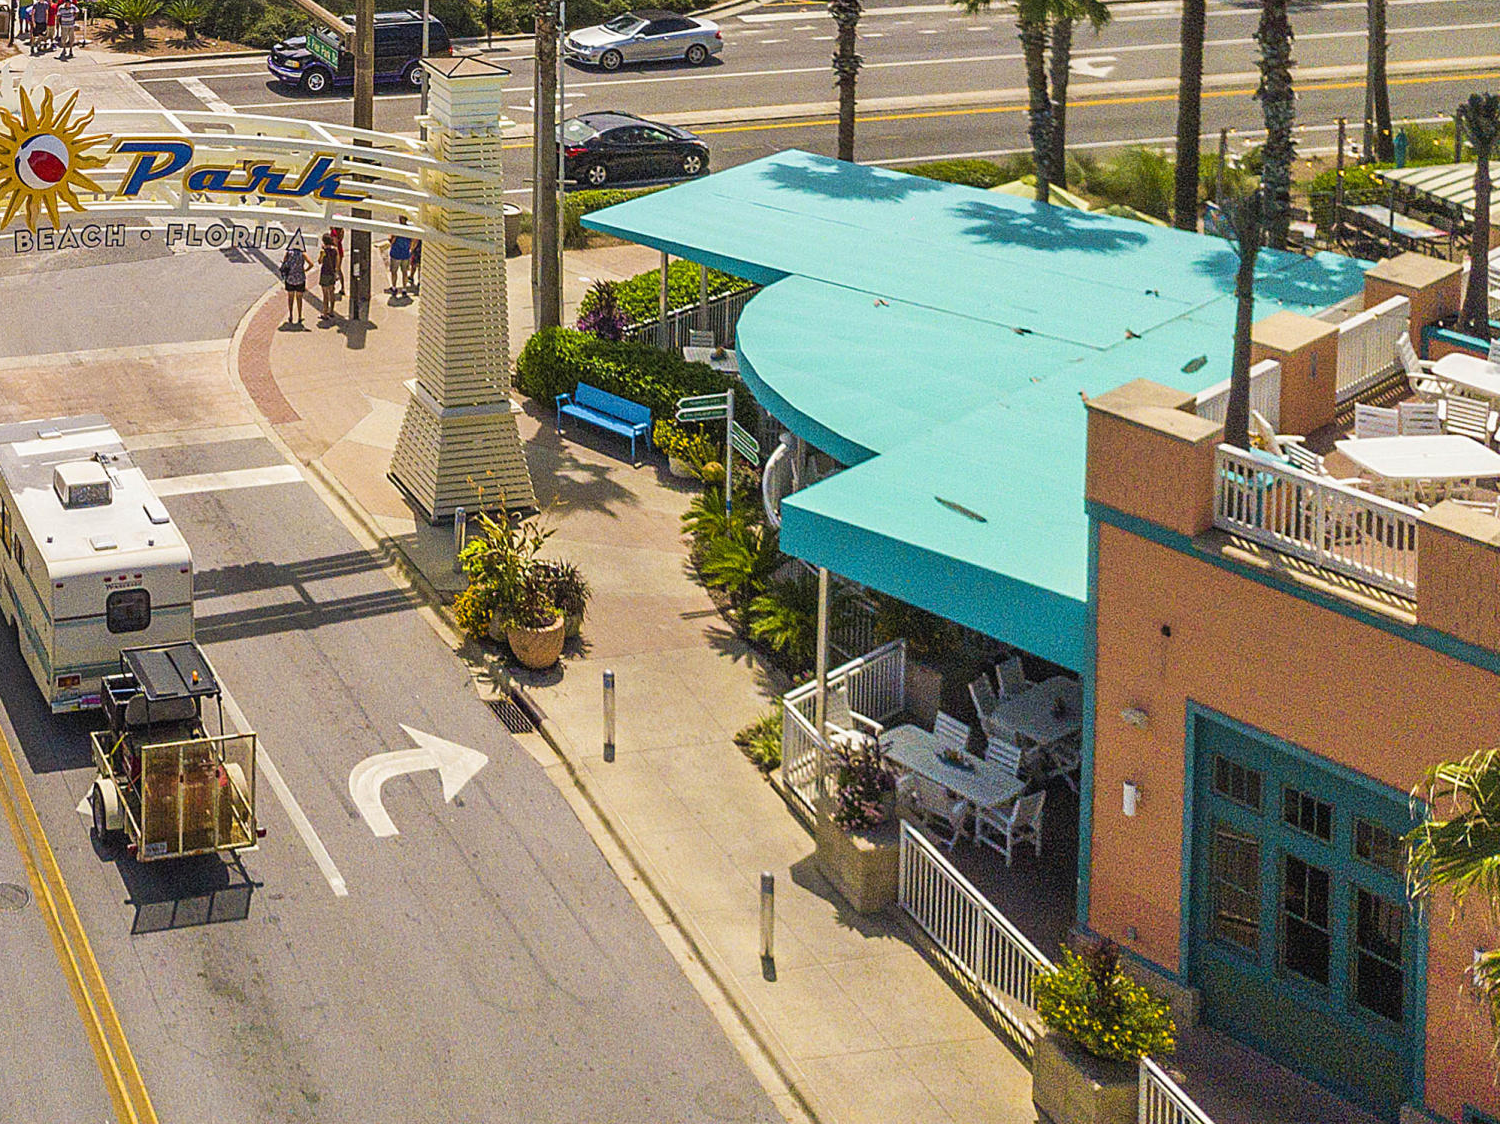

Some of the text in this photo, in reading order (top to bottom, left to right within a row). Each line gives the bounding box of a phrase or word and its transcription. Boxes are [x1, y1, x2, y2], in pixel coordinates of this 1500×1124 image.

[106, 136, 370, 203] Park
[14, 224, 126, 253] BEACH
[166, 223, 306, 252] FLORIDA
